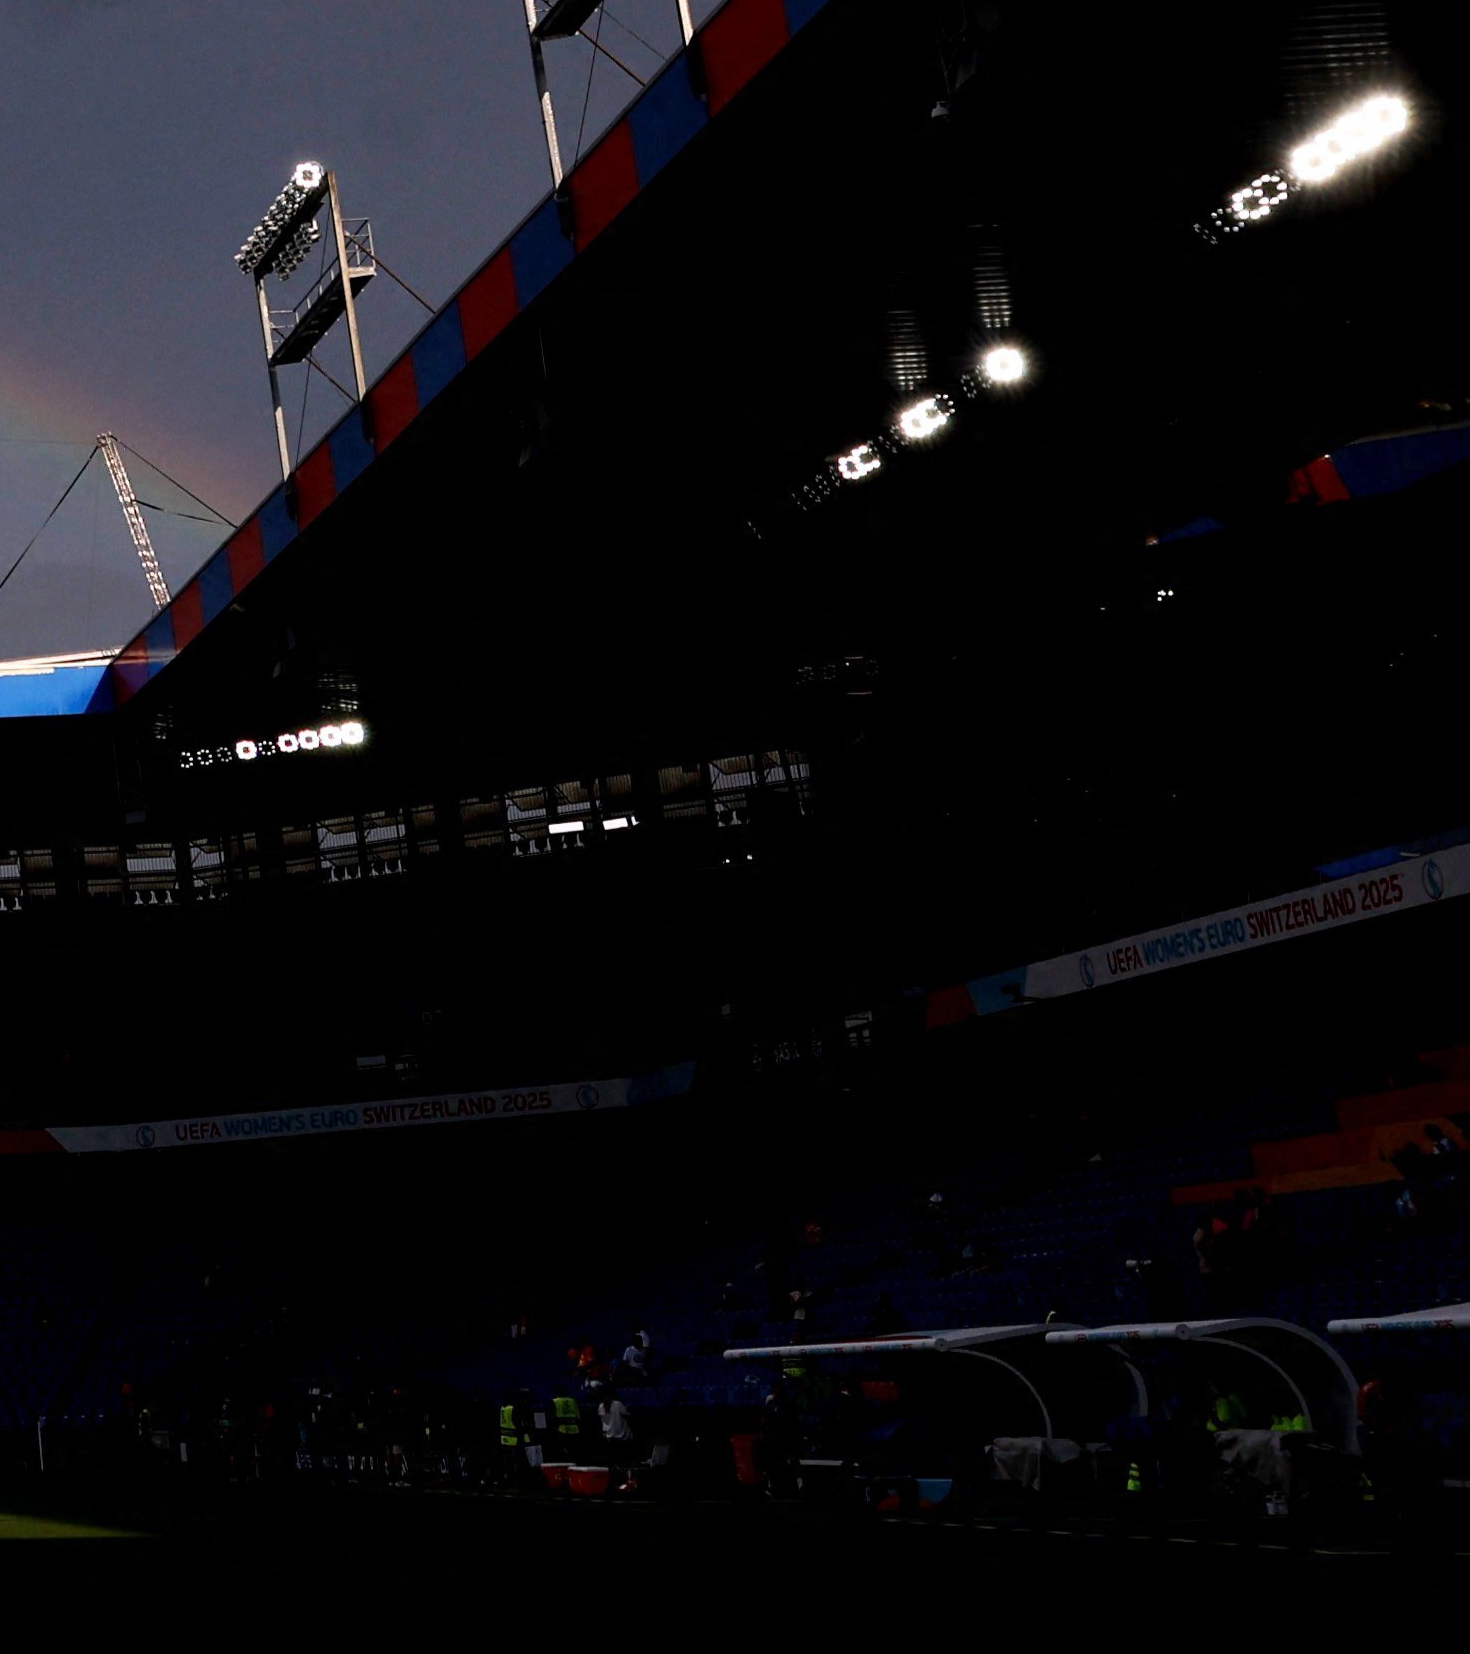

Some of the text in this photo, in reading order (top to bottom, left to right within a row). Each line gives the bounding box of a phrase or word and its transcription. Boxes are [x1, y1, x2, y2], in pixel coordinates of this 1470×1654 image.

[1106, 874, 1403, 975] UEFA WOMEN'S EURO SWITZERLAND 2025
[175, 1091, 553, 1141] UEFA WOMEN'S EURO SWITZERLAND 2025
